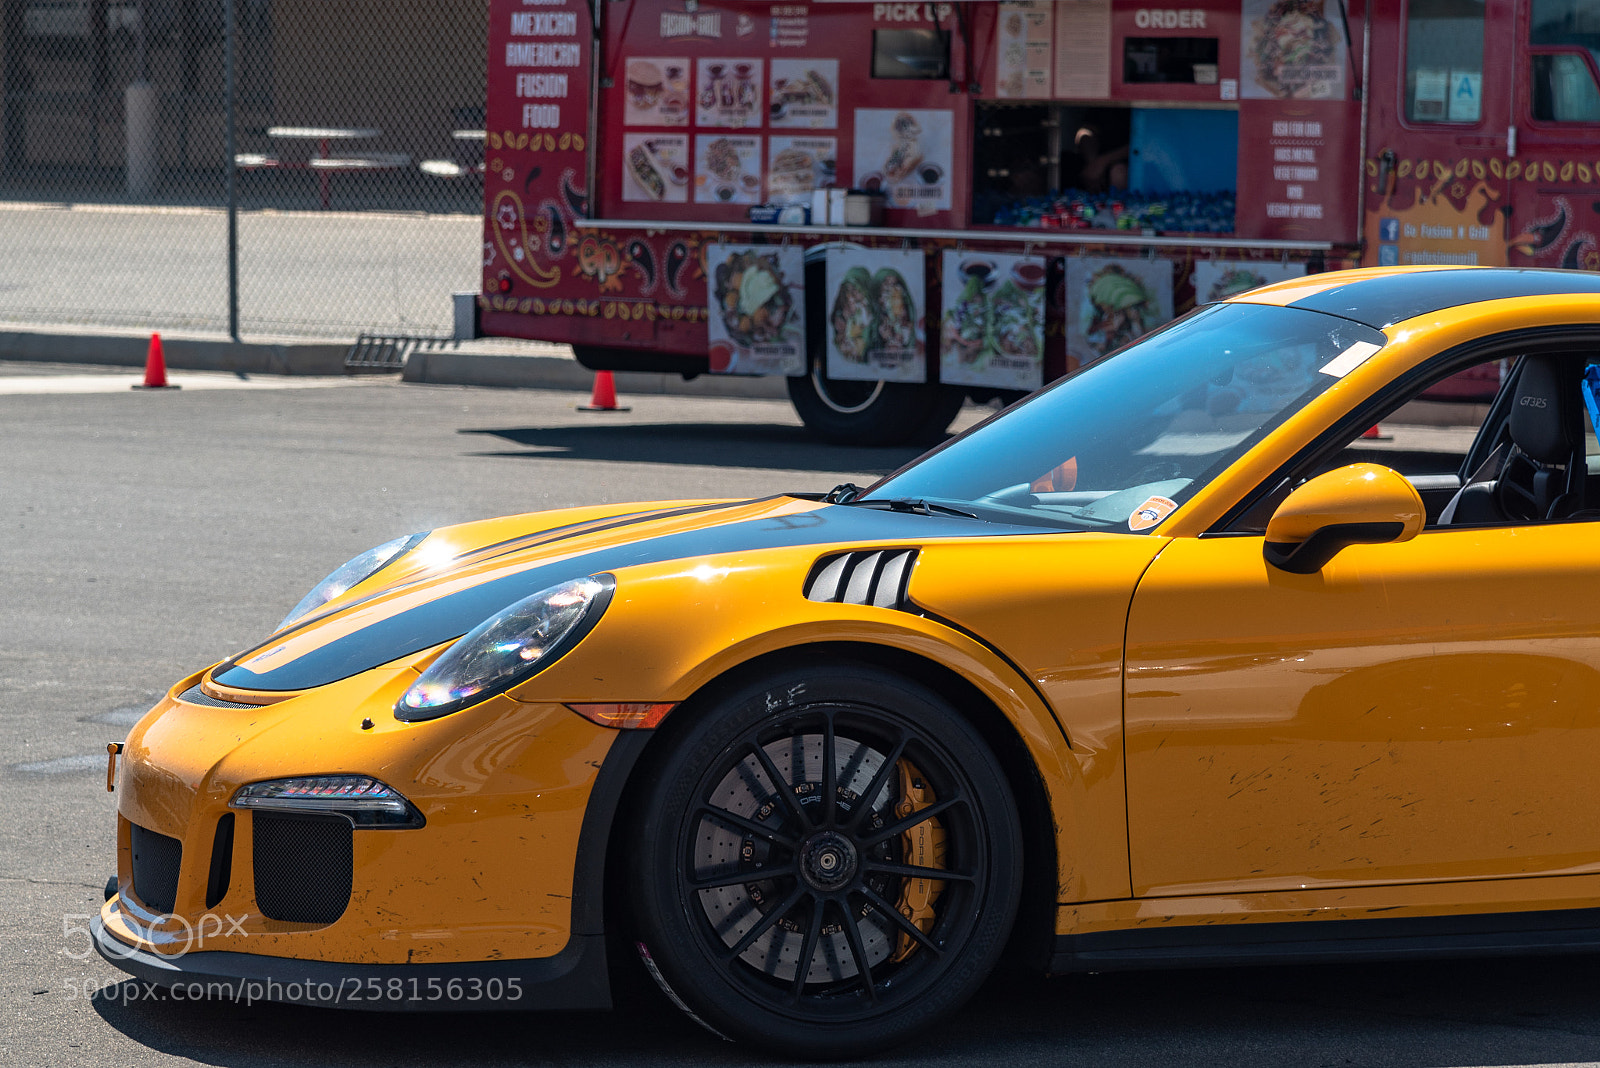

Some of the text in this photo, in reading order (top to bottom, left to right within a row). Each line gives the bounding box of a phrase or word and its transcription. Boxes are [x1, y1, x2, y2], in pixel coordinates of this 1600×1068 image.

[873, 3, 952, 21] PICK UP
[1135, 9, 1206, 29] ORDER
[510, 12, 577, 36] MEXICAN
[505, 43, 581, 67] AMERICAN
[516, 73, 568, 98] FUSION
[1457, 77, 1474, 98] A
[522, 104, 560, 128] FOOD
[1403, 224, 1416, 237] Go
[1420, 224, 1452, 239] Fusion
[1468, 224, 1489, 240] Grill
